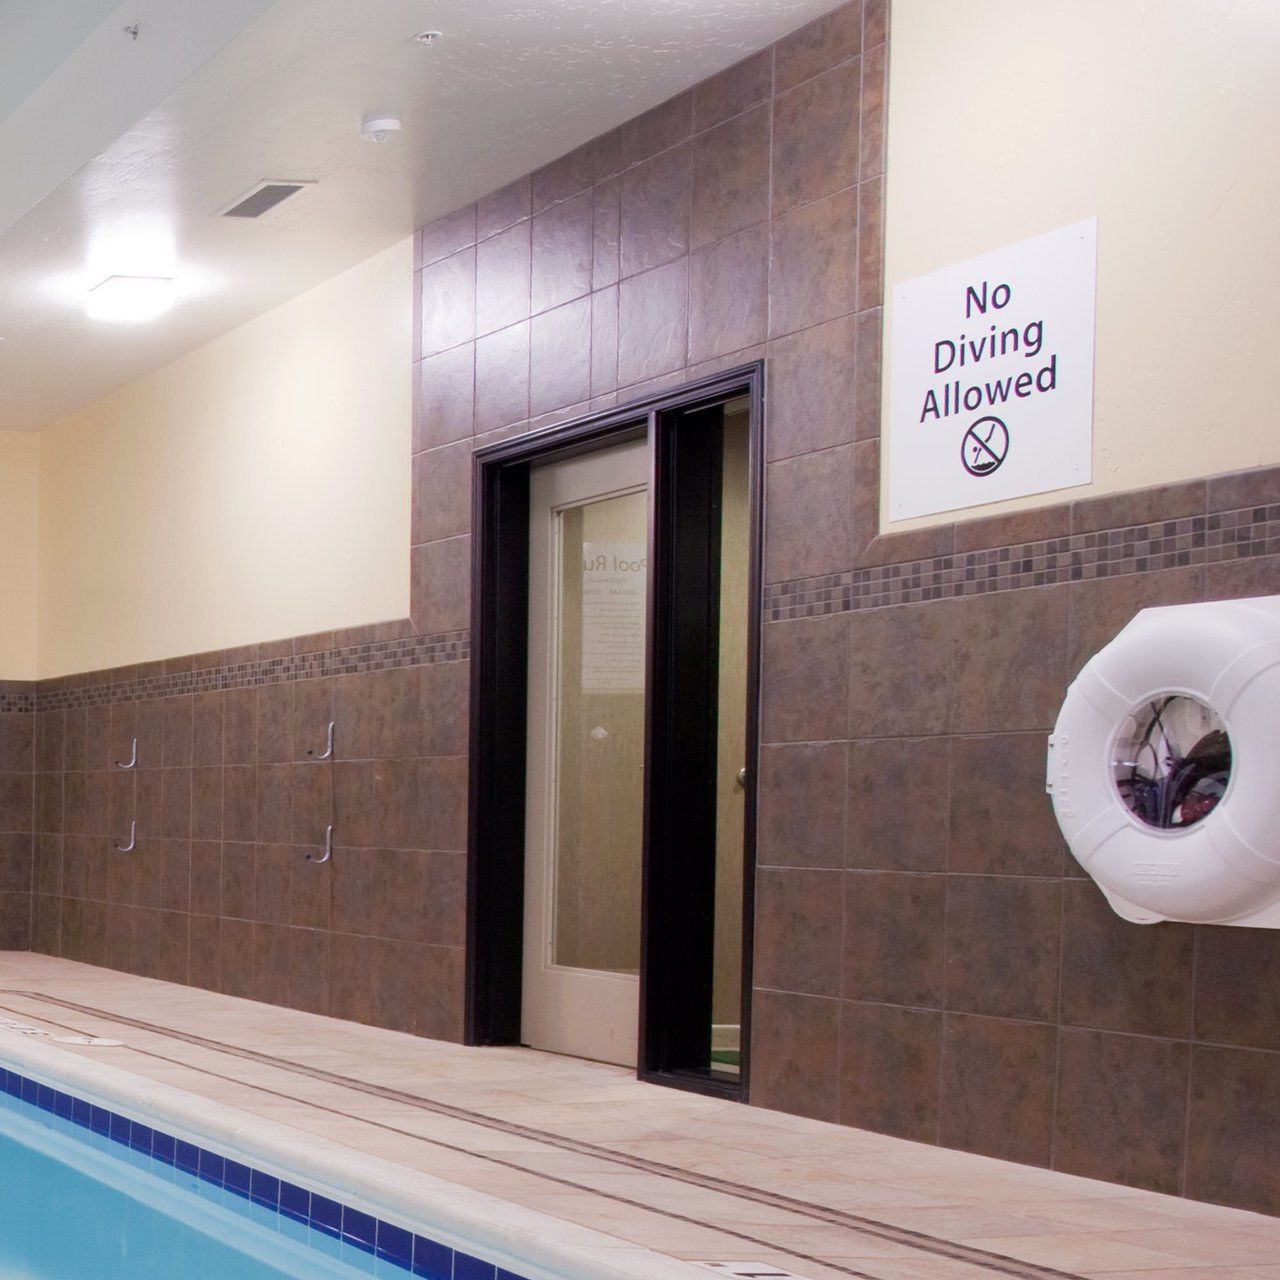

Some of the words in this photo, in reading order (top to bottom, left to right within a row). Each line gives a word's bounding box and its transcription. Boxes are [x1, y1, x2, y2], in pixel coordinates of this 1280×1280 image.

[966, 281, 1011, 318] No
[934, 320, 1043, 374] Diving
[920, 354, 1057, 423] Allowed
